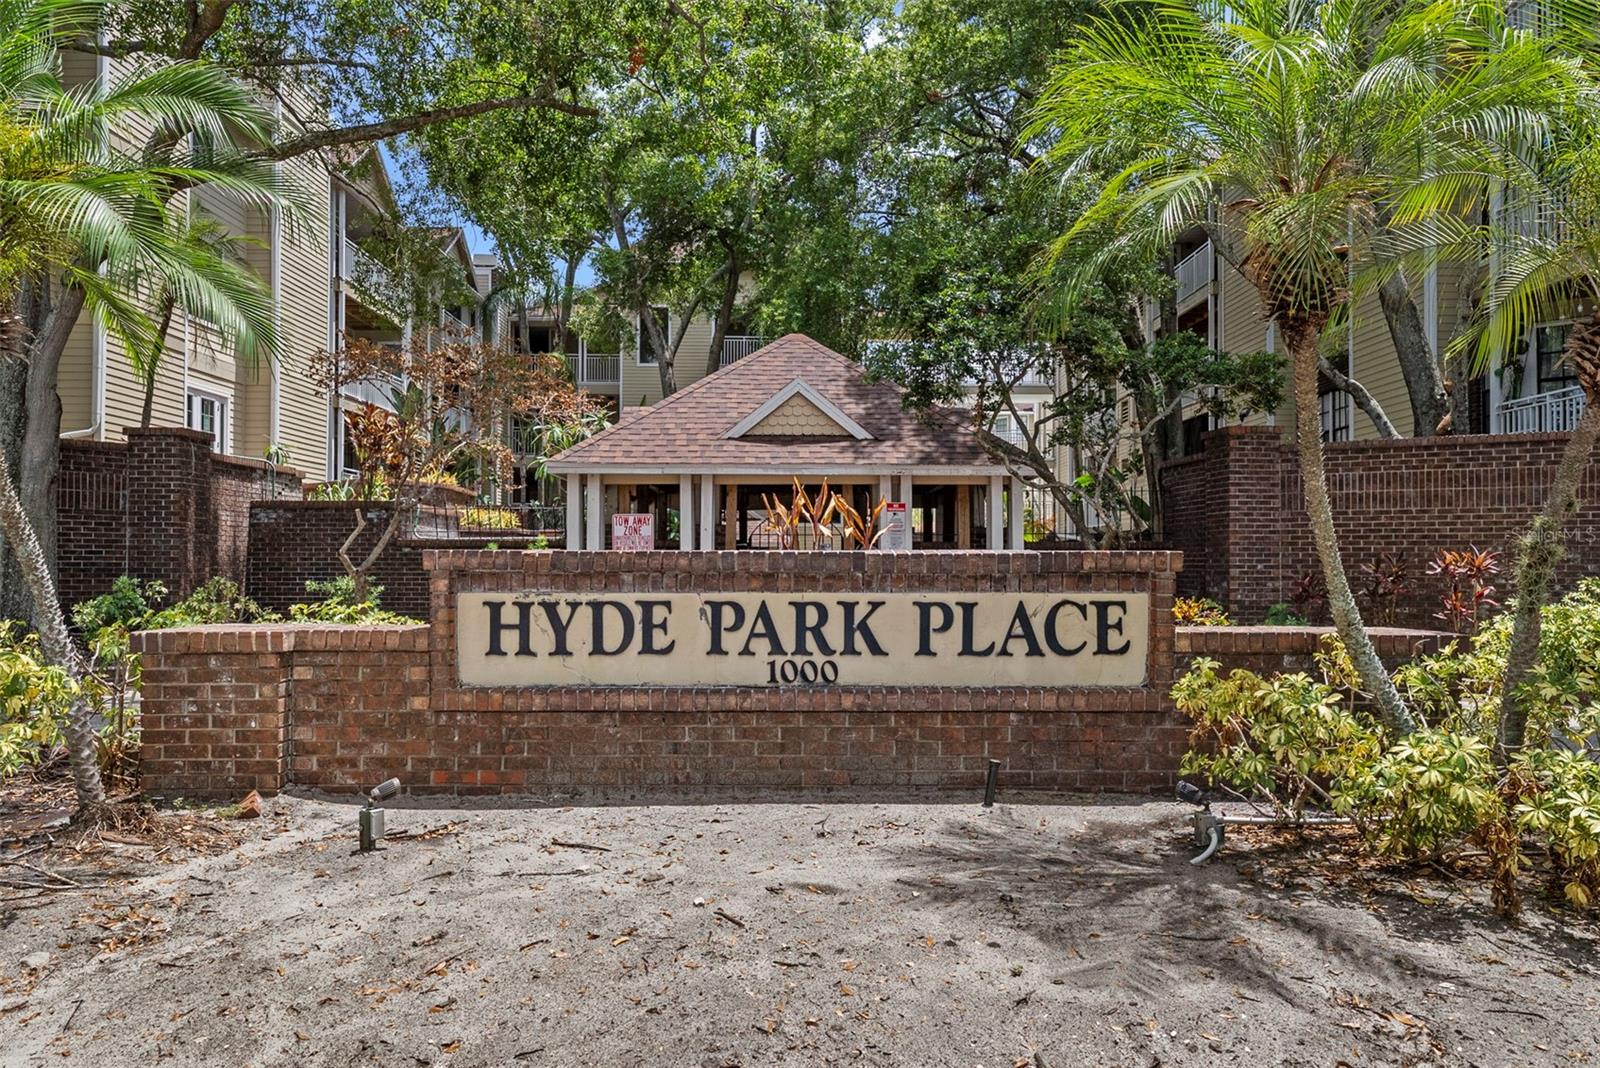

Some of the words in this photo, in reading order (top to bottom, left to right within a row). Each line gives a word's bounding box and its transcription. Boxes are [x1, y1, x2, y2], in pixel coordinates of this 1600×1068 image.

[614, 515, 629, 526] TOW
[632, 515, 651, 526] AWAY
[623, 525, 642, 536] ZONE
[483, 600, 676, 658] HYDE
[705, 600, 890, 657] PARK
[912, 600, 1131, 658] PLACE
[766, 659, 840, 685] 1000
